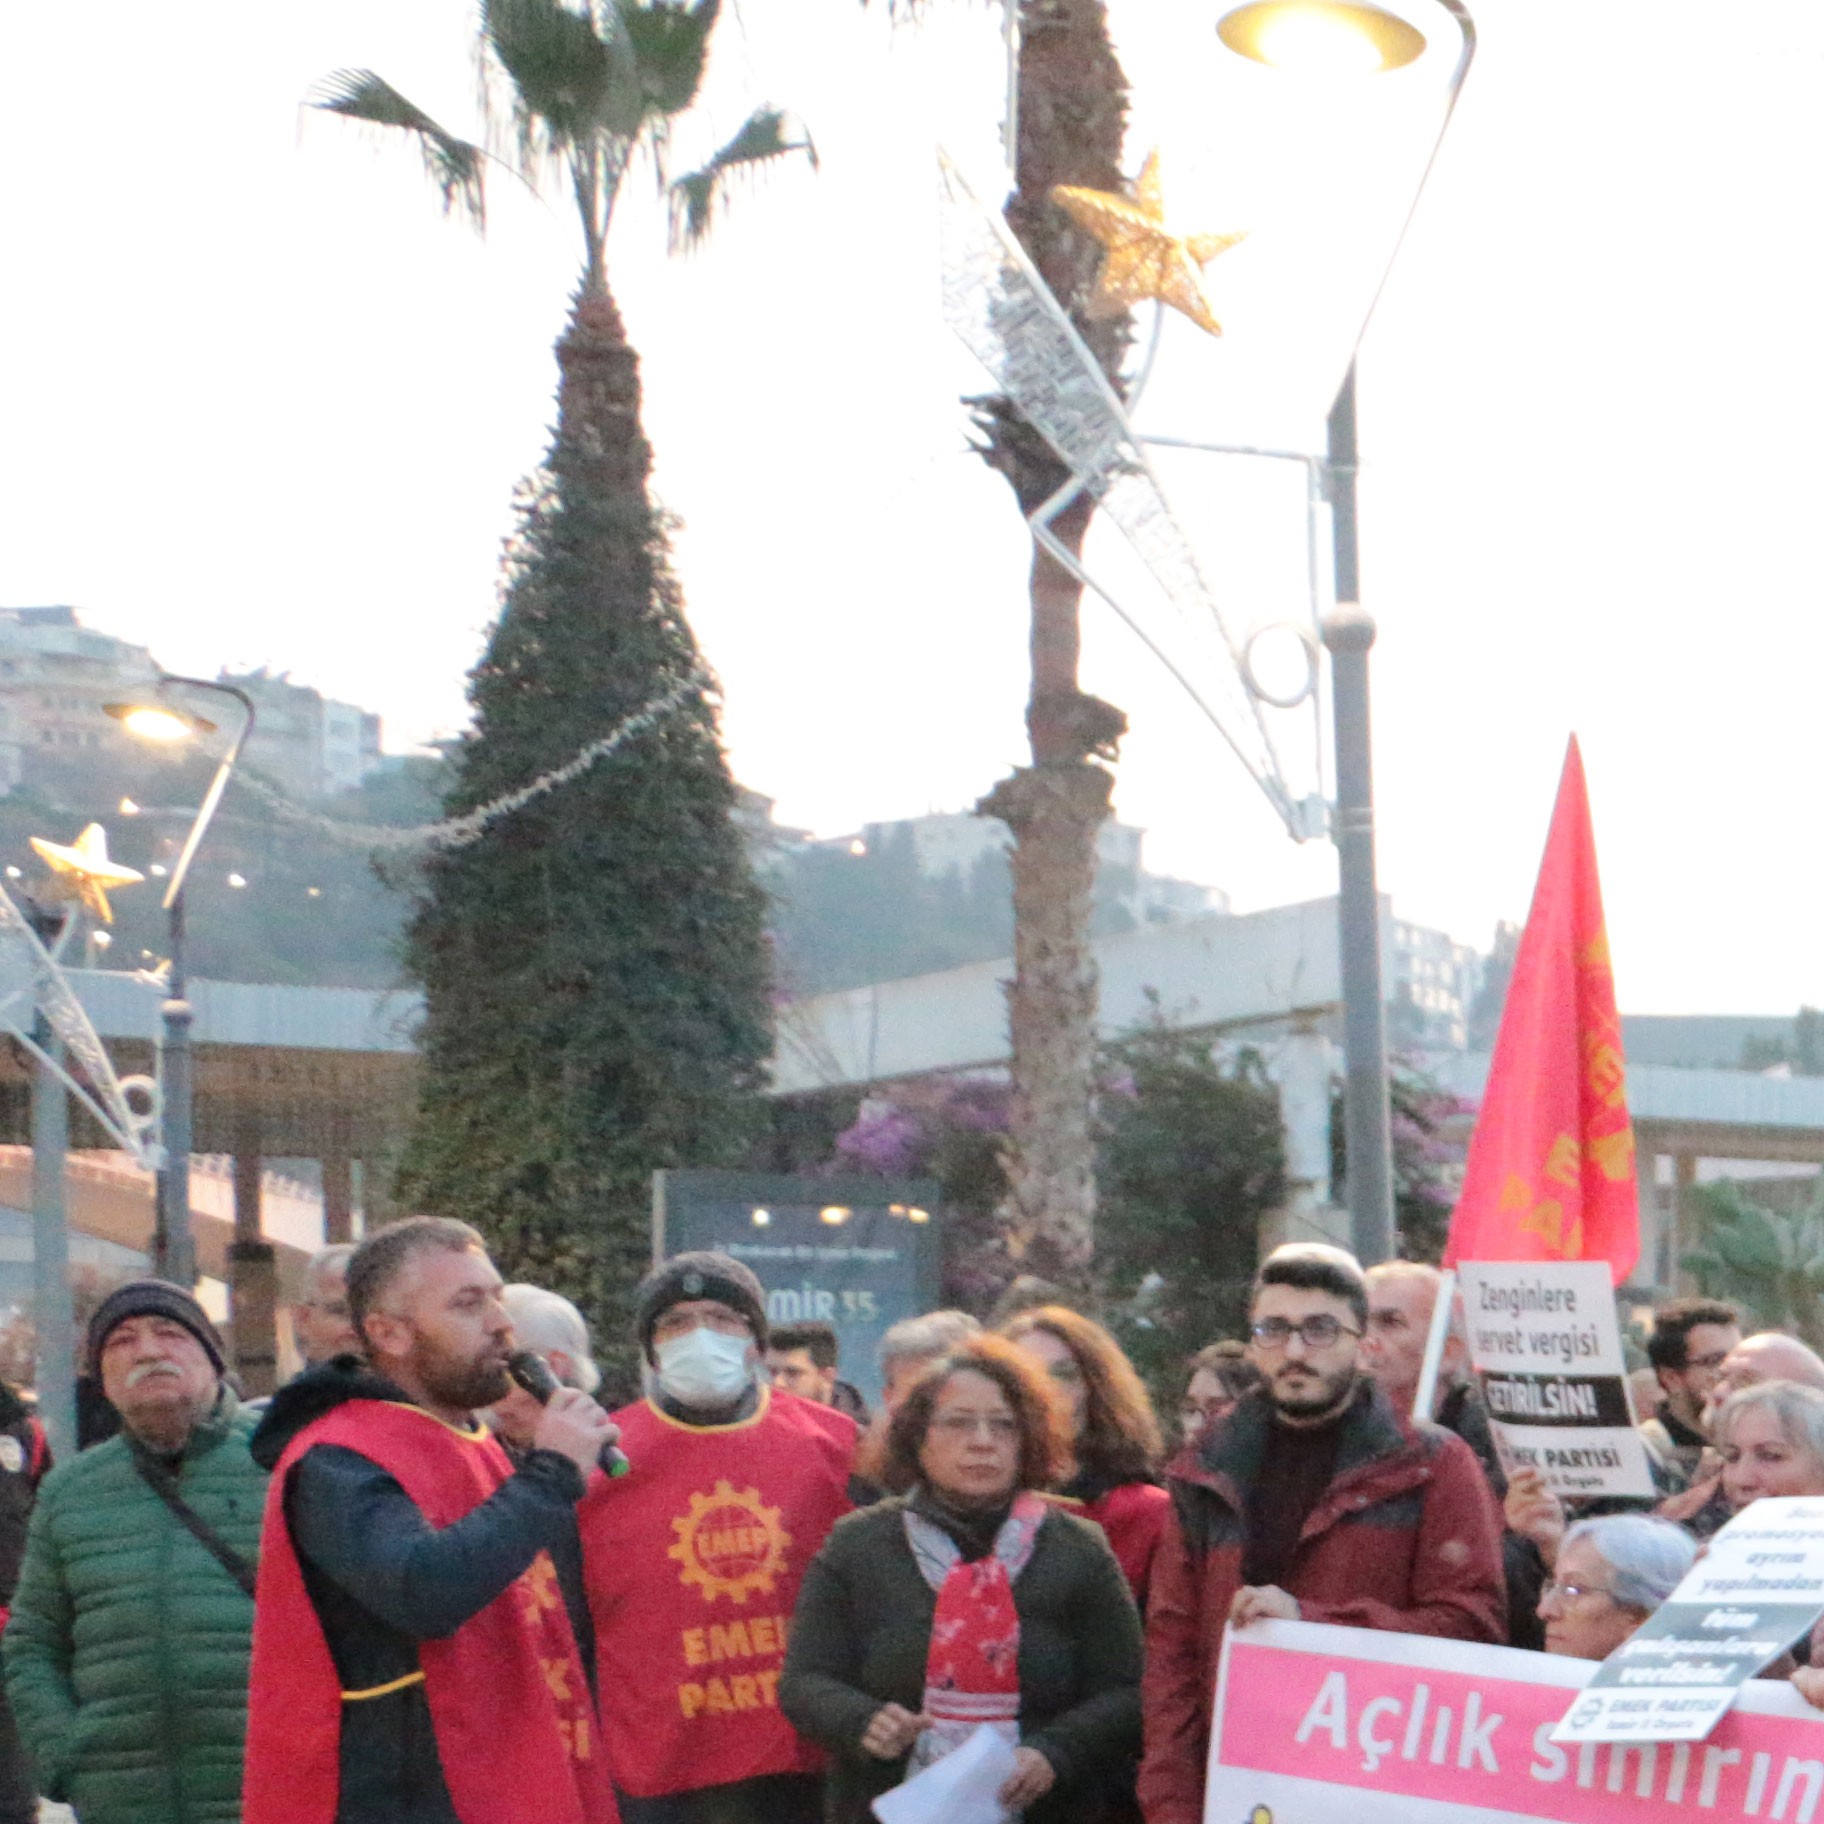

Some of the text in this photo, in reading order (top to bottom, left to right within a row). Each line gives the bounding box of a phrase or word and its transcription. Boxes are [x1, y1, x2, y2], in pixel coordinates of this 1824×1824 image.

[1479, 1280, 1576, 1317] Zenginlere
[1529, 1323, 1600, 1363] vergisi
[1295, 1671, 1504, 1773] Açlık
